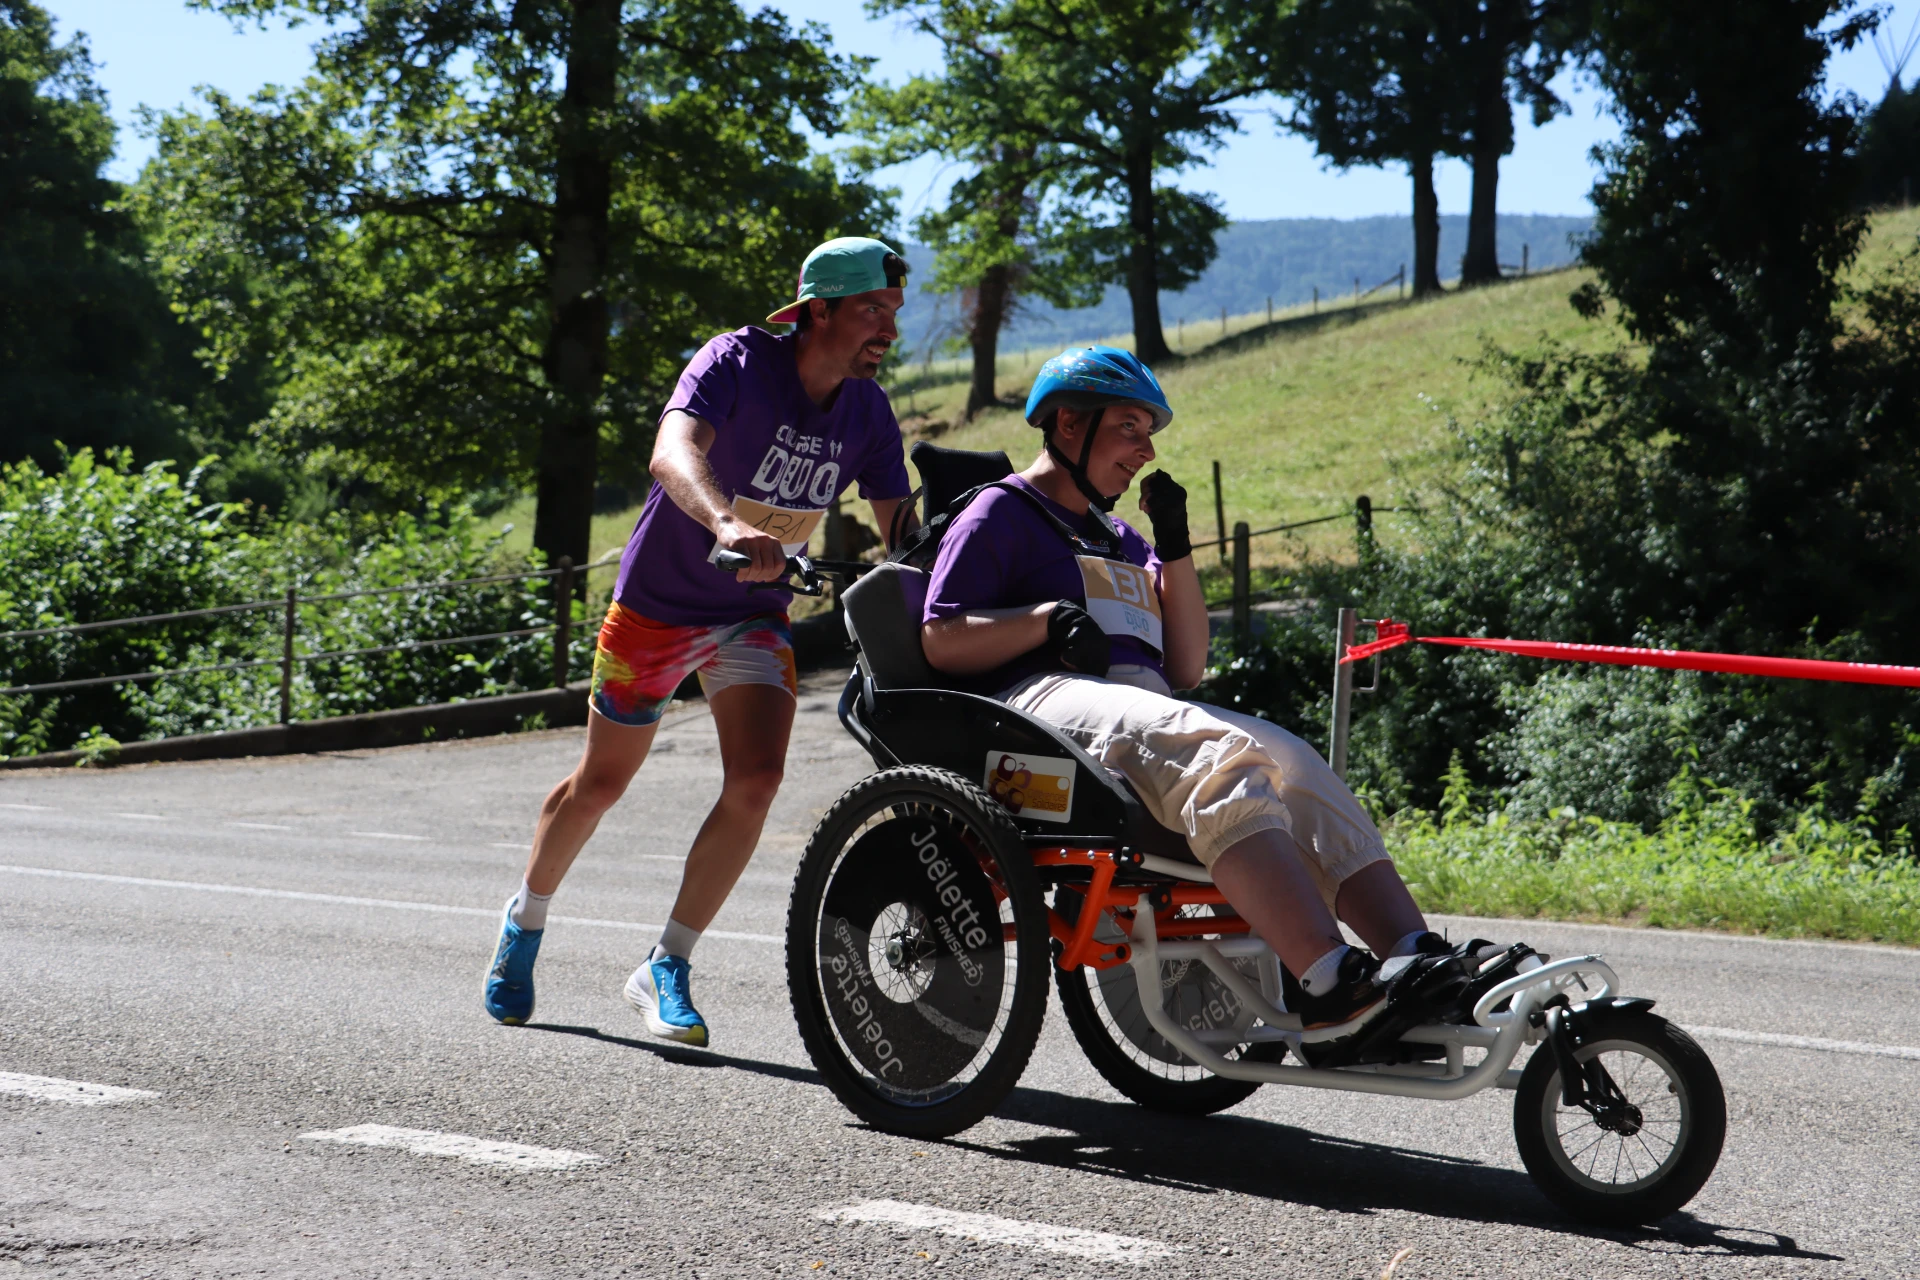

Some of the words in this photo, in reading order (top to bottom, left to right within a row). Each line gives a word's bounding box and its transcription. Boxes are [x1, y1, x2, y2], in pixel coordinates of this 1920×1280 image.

[751, 445, 840, 505] DUO
[753, 511, 806, 541] 131
[1105, 564, 1149, 608] 131
[1124, 611, 1150, 632] DUO
[911, 825, 987, 949] Joëlette
[838, 925, 872, 987] FINISHER
[934, 915, 978, 979] FINISHER
[832, 953, 903, 1078] Joëlette
